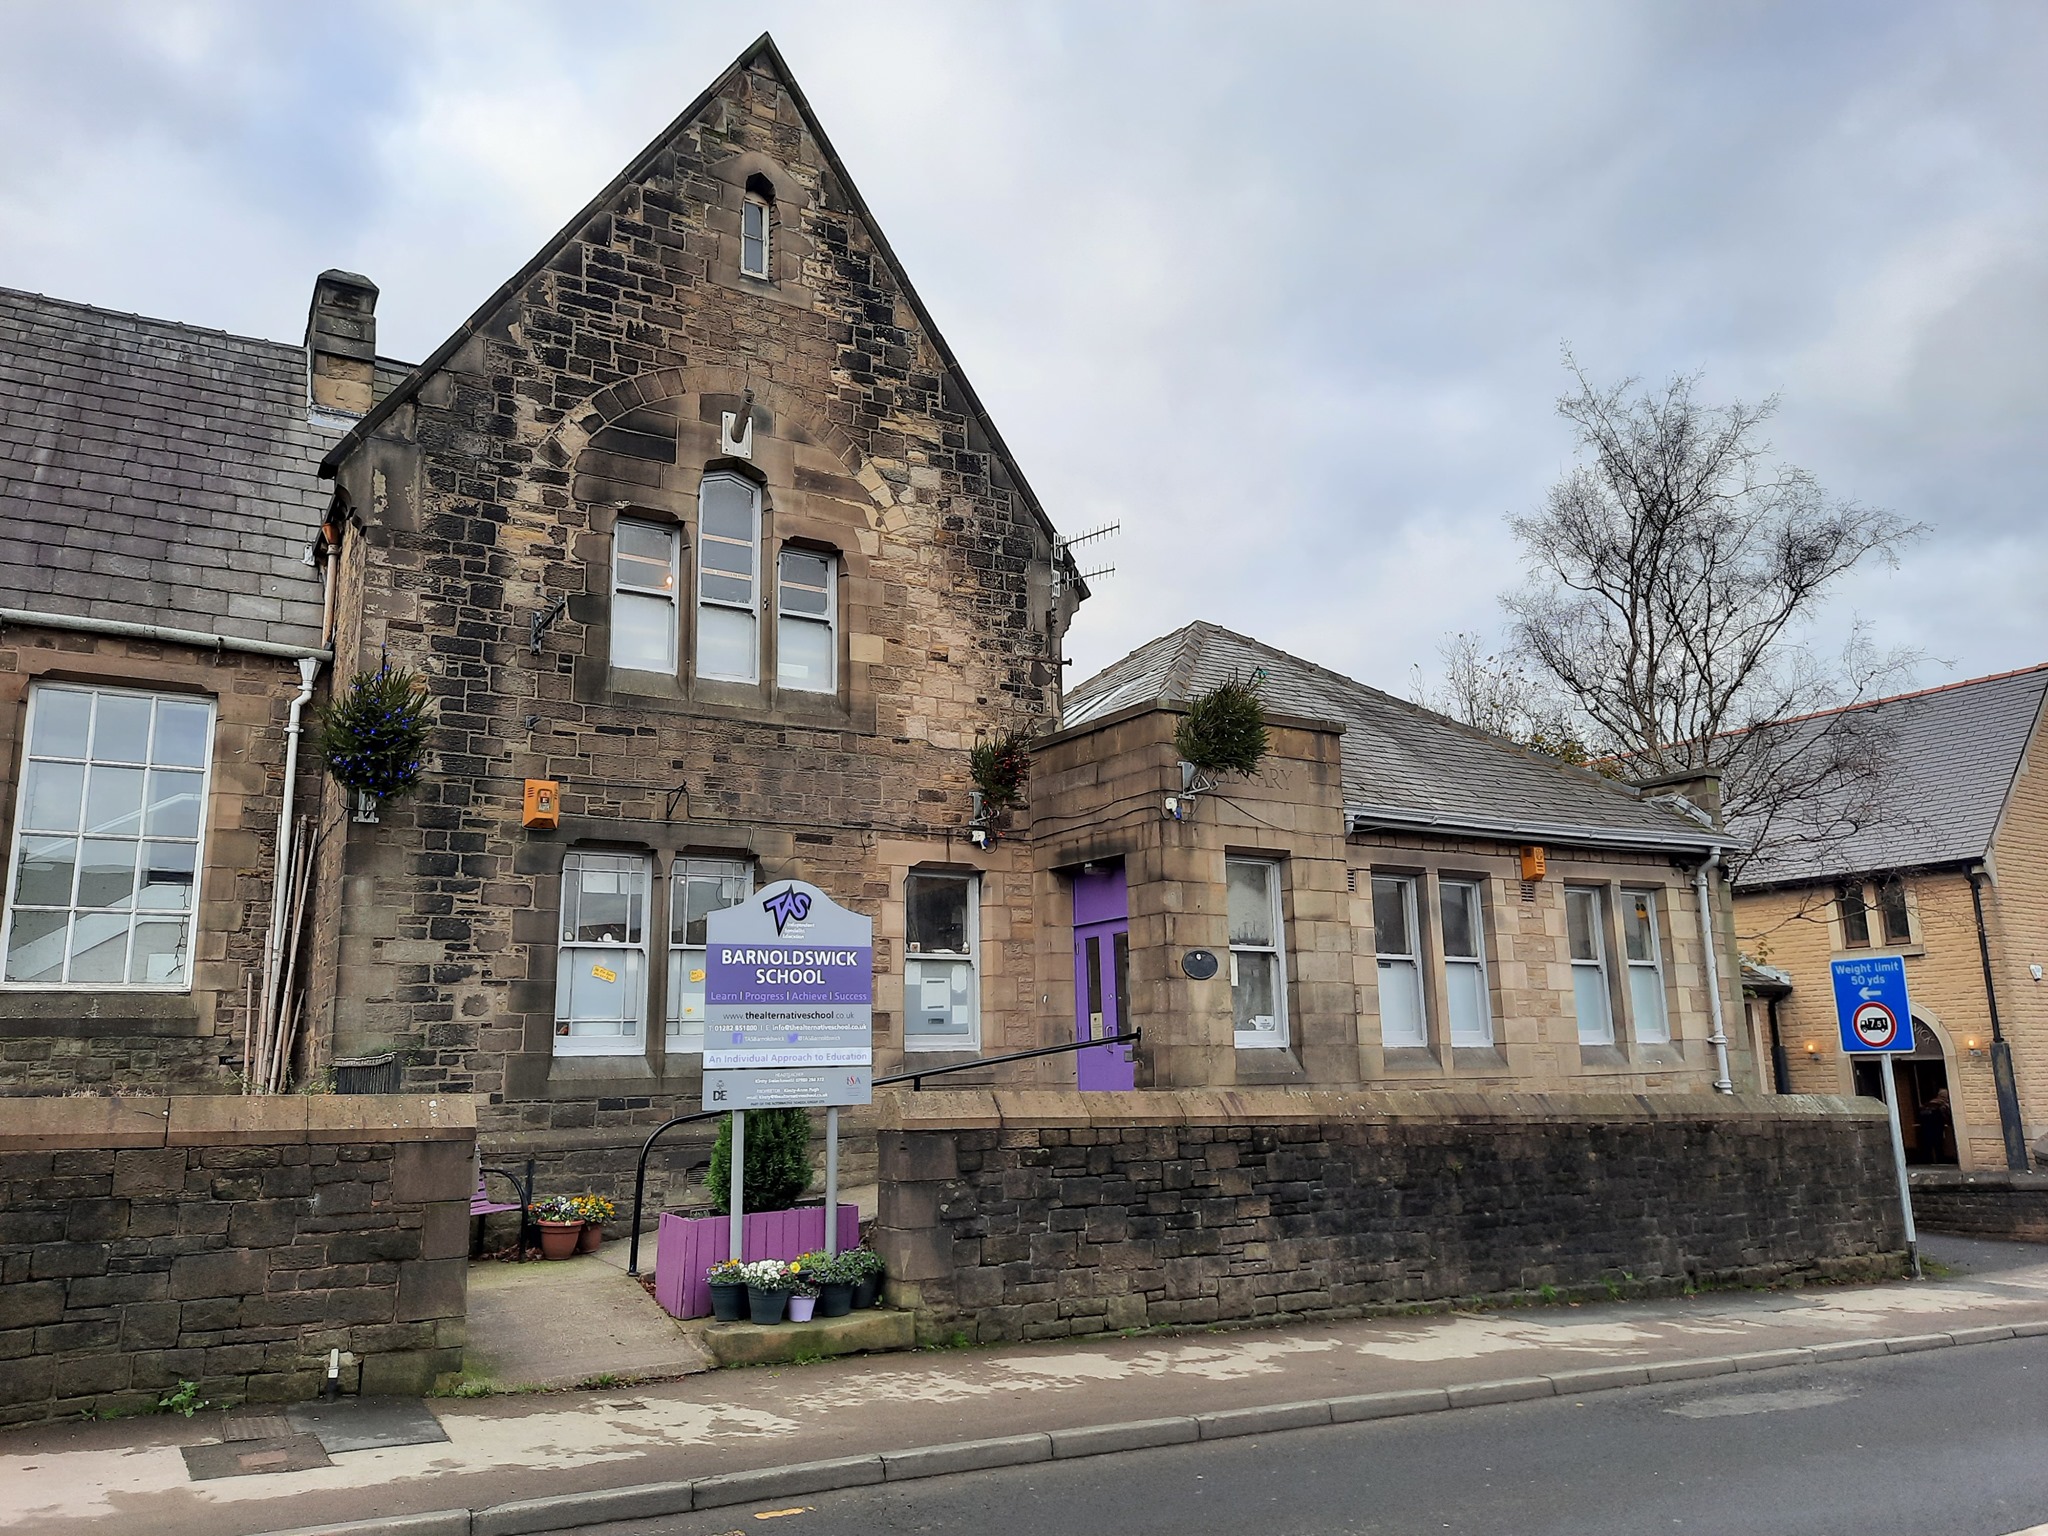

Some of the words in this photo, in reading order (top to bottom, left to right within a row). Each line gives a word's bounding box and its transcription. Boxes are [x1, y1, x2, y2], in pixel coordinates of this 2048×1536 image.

[763, 884, 812, 937] TAS
[721, 949, 858, 966] BARNOLDSWICK
[1835, 964, 1871, 975] Weight
[1874, 961, 1899, 972] limit
[756, 968, 826, 984] SCHOOL
[1851, 975, 1865, 986] 50
[1867, 974, 1886, 986] yds
[711, 991, 737, 1001] Learn
[745, 991, 784, 1002] Progress
[791, 991, 827, 1001] Achieve
[834, 991, 867, 1001] Success
[708, 1055, 722, 1064] An
[724, 1054, 769, 1063] Individual
[771, 1053, 813, 1063] Approach
[814, 1053, 824, 1061] to
[826, 1052, 867, 1061] Education
